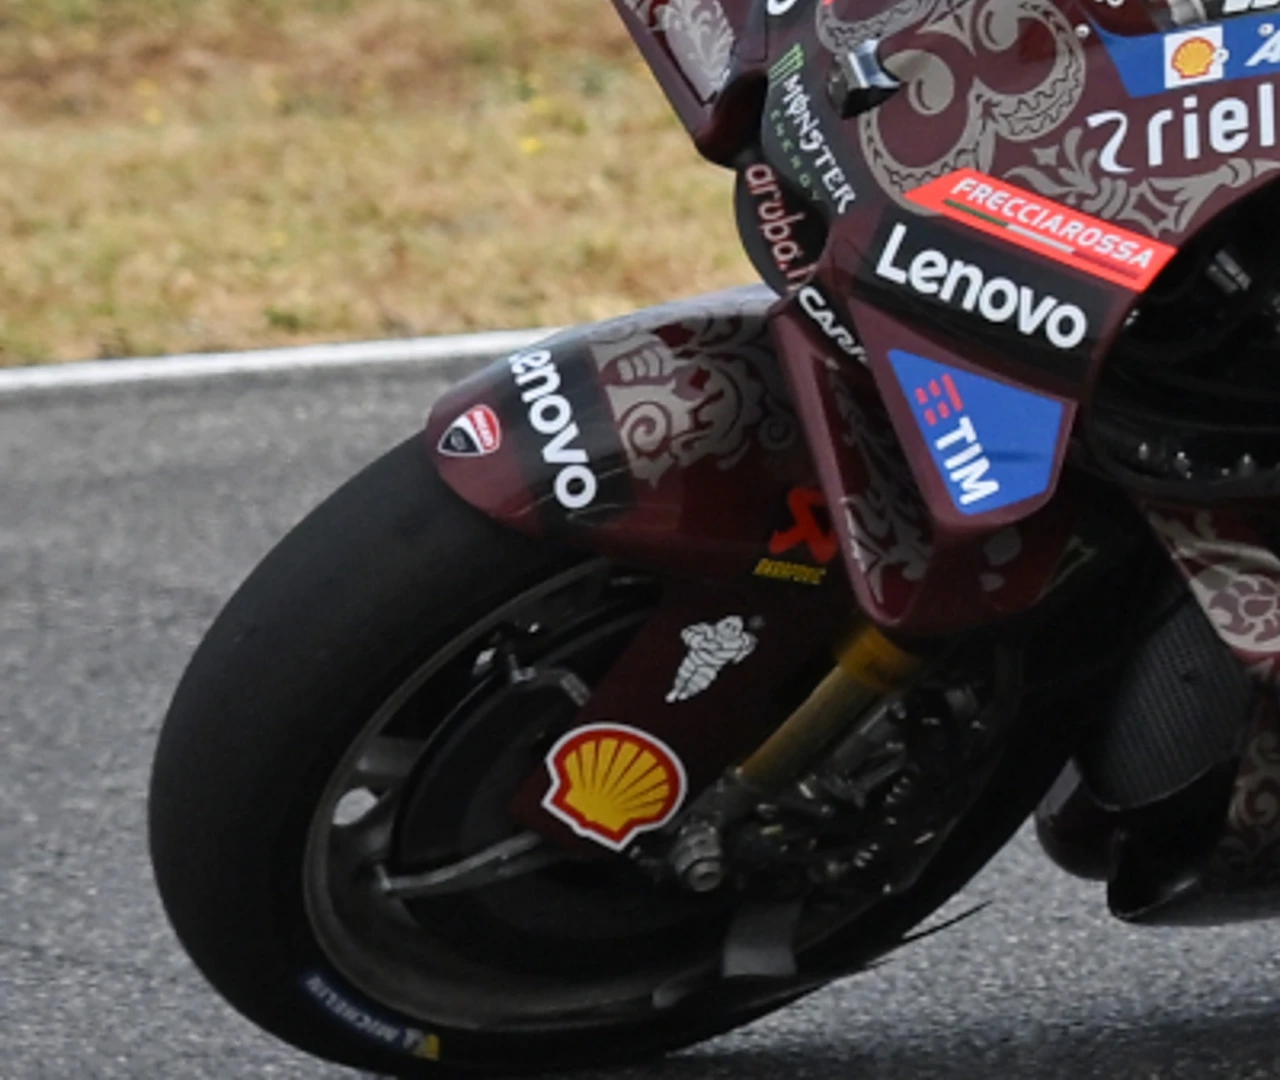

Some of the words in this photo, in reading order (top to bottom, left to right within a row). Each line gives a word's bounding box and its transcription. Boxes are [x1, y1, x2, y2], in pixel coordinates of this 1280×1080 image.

[783, 74, 856, 216] MONSTER
[951, 177, 1156, 269] FRECCIAROSSA
[875, 224, 1087, 349] Lenovo
[934, 415, 1000, 506] TIM
